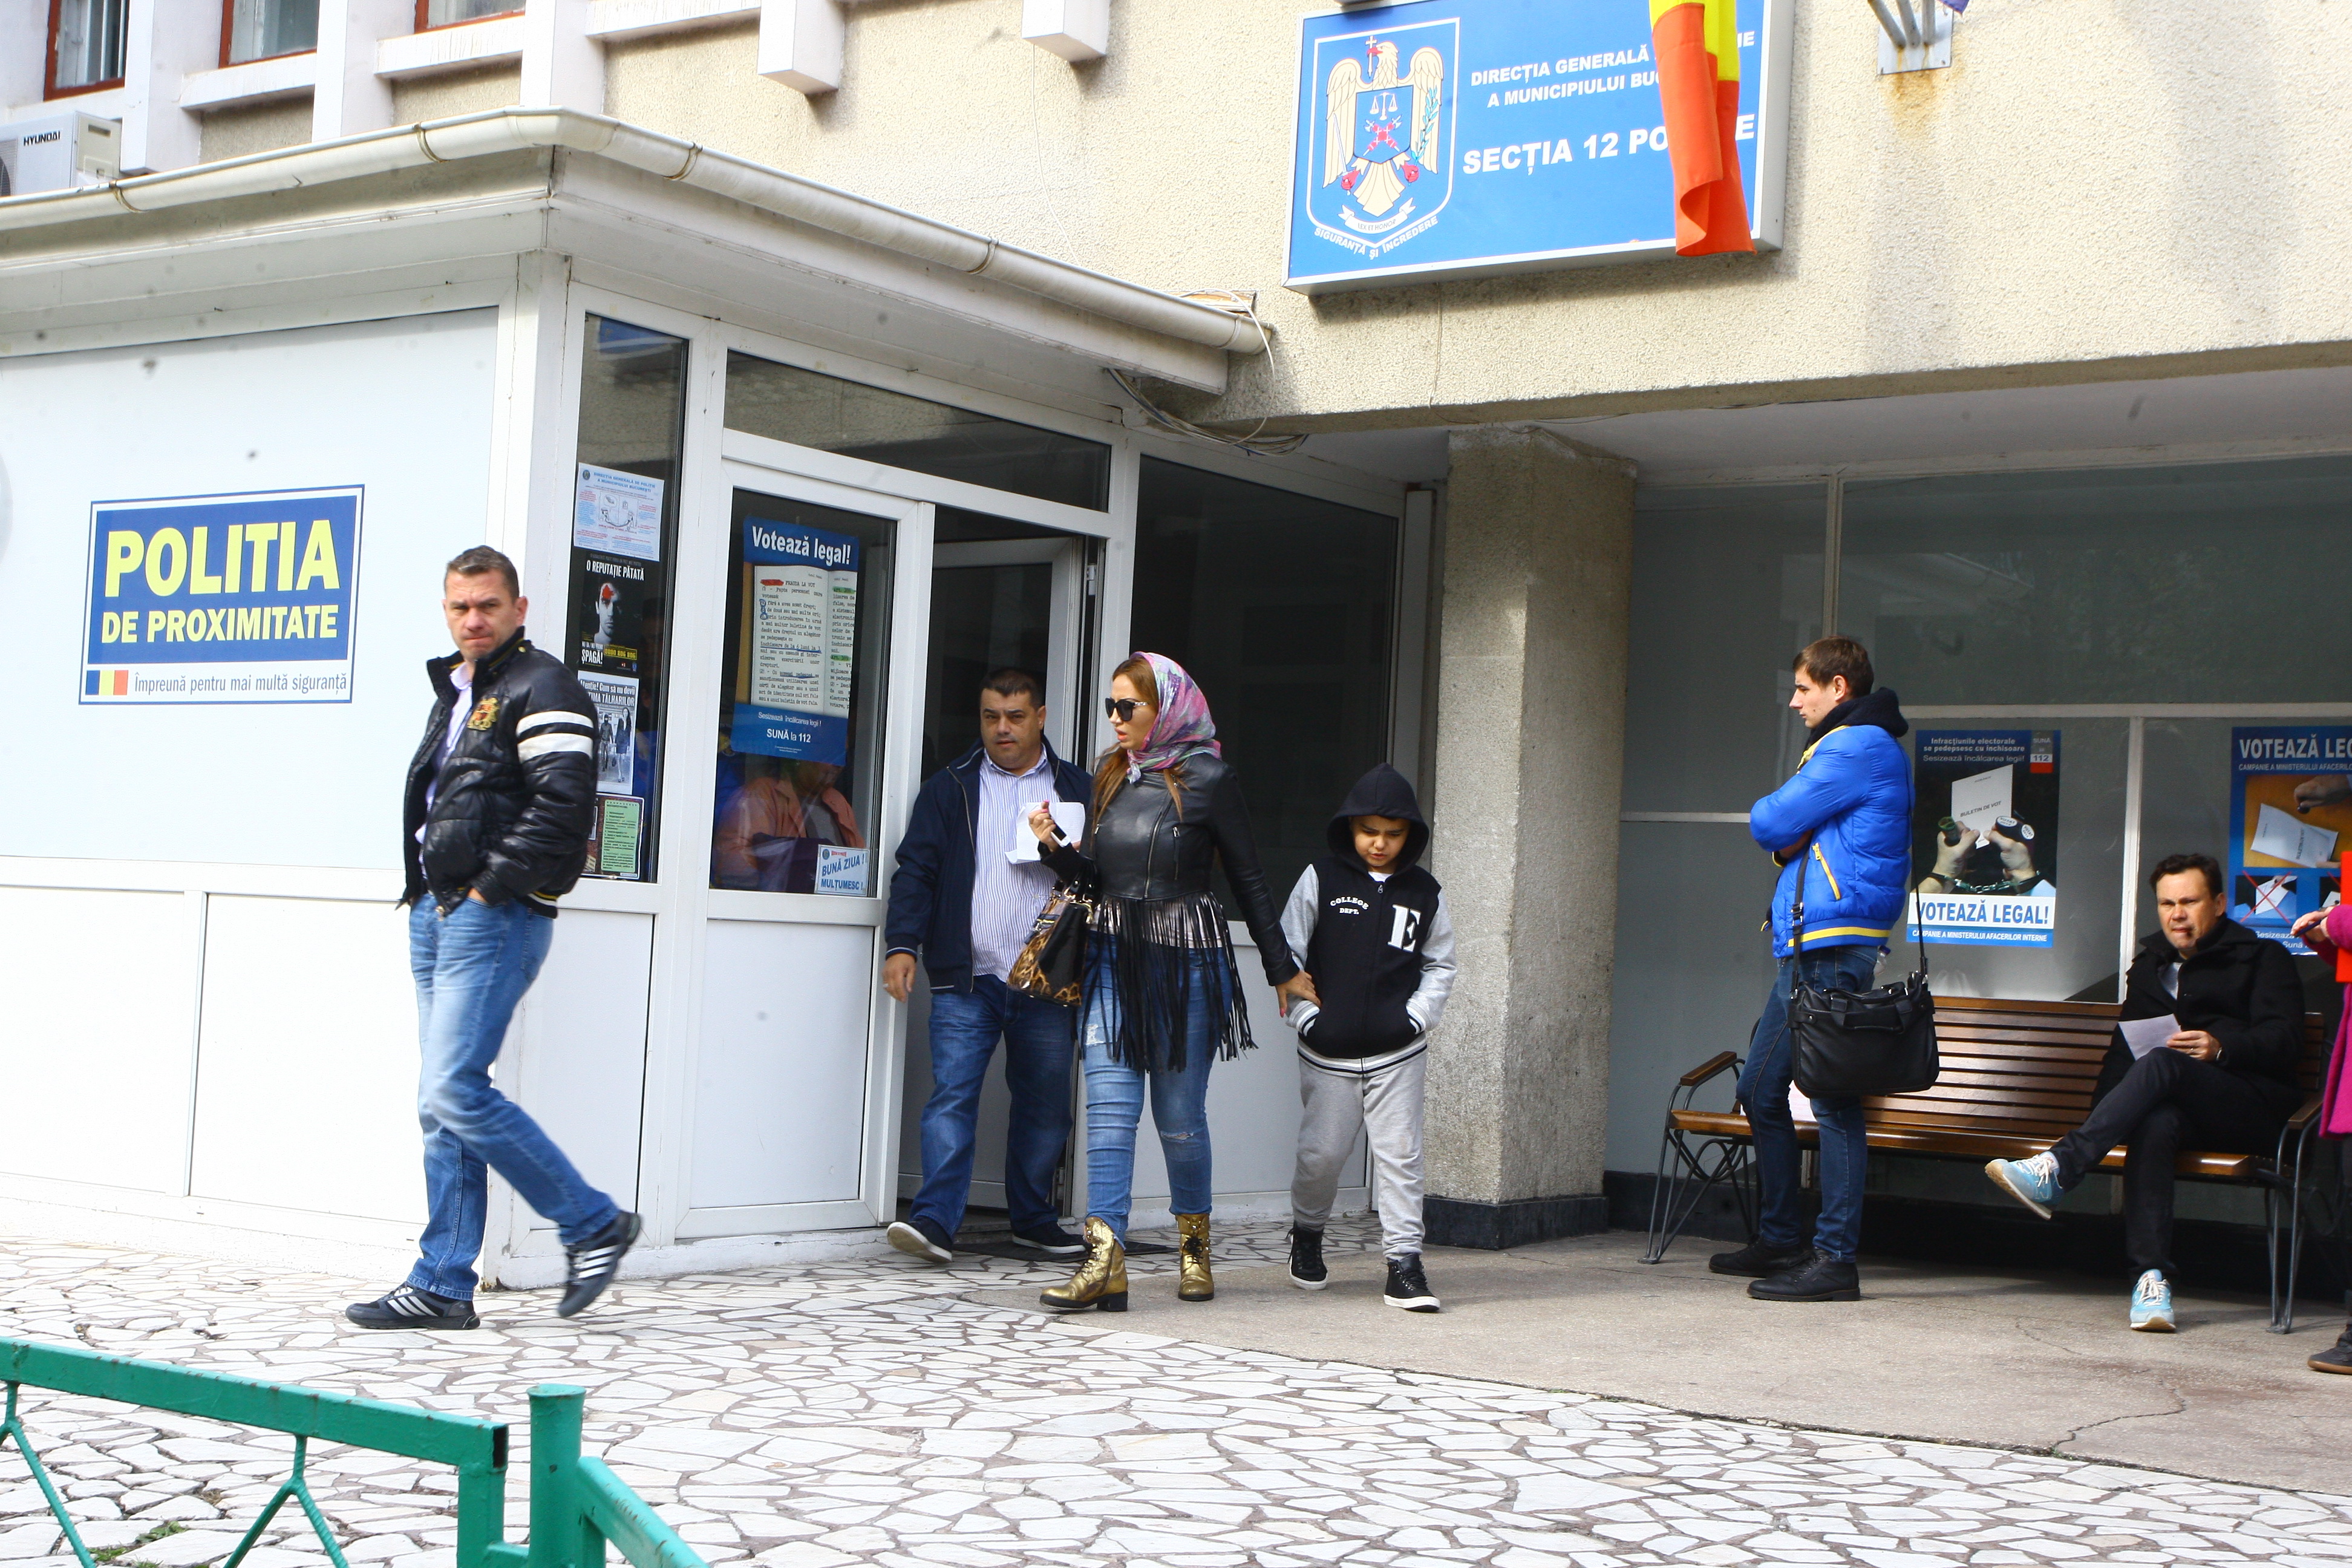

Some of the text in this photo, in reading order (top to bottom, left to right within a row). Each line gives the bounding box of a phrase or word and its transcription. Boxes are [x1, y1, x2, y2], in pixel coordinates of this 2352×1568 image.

[1471, 45, 1650, 87] DIRECȚIA GENERALĂ
[1487, 93, 1499, 108] A
[1504, 75, 1625, 105] MUNICIPIULUI
[24, 131, 60, 146] HYUNDAI
[1462, 139, 1573, 176] SECȚIA
[1583, 132, 1619, 159] 12
[105, 520, 340, 597] POLITIA
[752, 525, 851, 566] Votează legal!
[586, 560, 591, 571] O
[592, 561, 622, 578] REPUTAȚIE
[622, 565, 644, 581] PĂTATĂ
[102, 605, 339, 643] DE PROXIMITATE
[581, 648, 603, 665] ȘPAGĂ!
[135, 672, 347, 696] Împreună pentru mai multă siguranță
[766, 728, 811, 743] SUNĂ la 112
[2239, 733, 2319, 759] VOTEAZĂ
[1960, 806, 1982, 817] BULETIN
[822, 858, 842, 877] BUNĂ
[843, 855, 860, 871] ZIUA
[1330, 896, 1369, 910] COLLEGE
[1916, 899, 2049, 925] VOTEAZĂ LEGAL!
[1387, 904, 1422, 953] E
